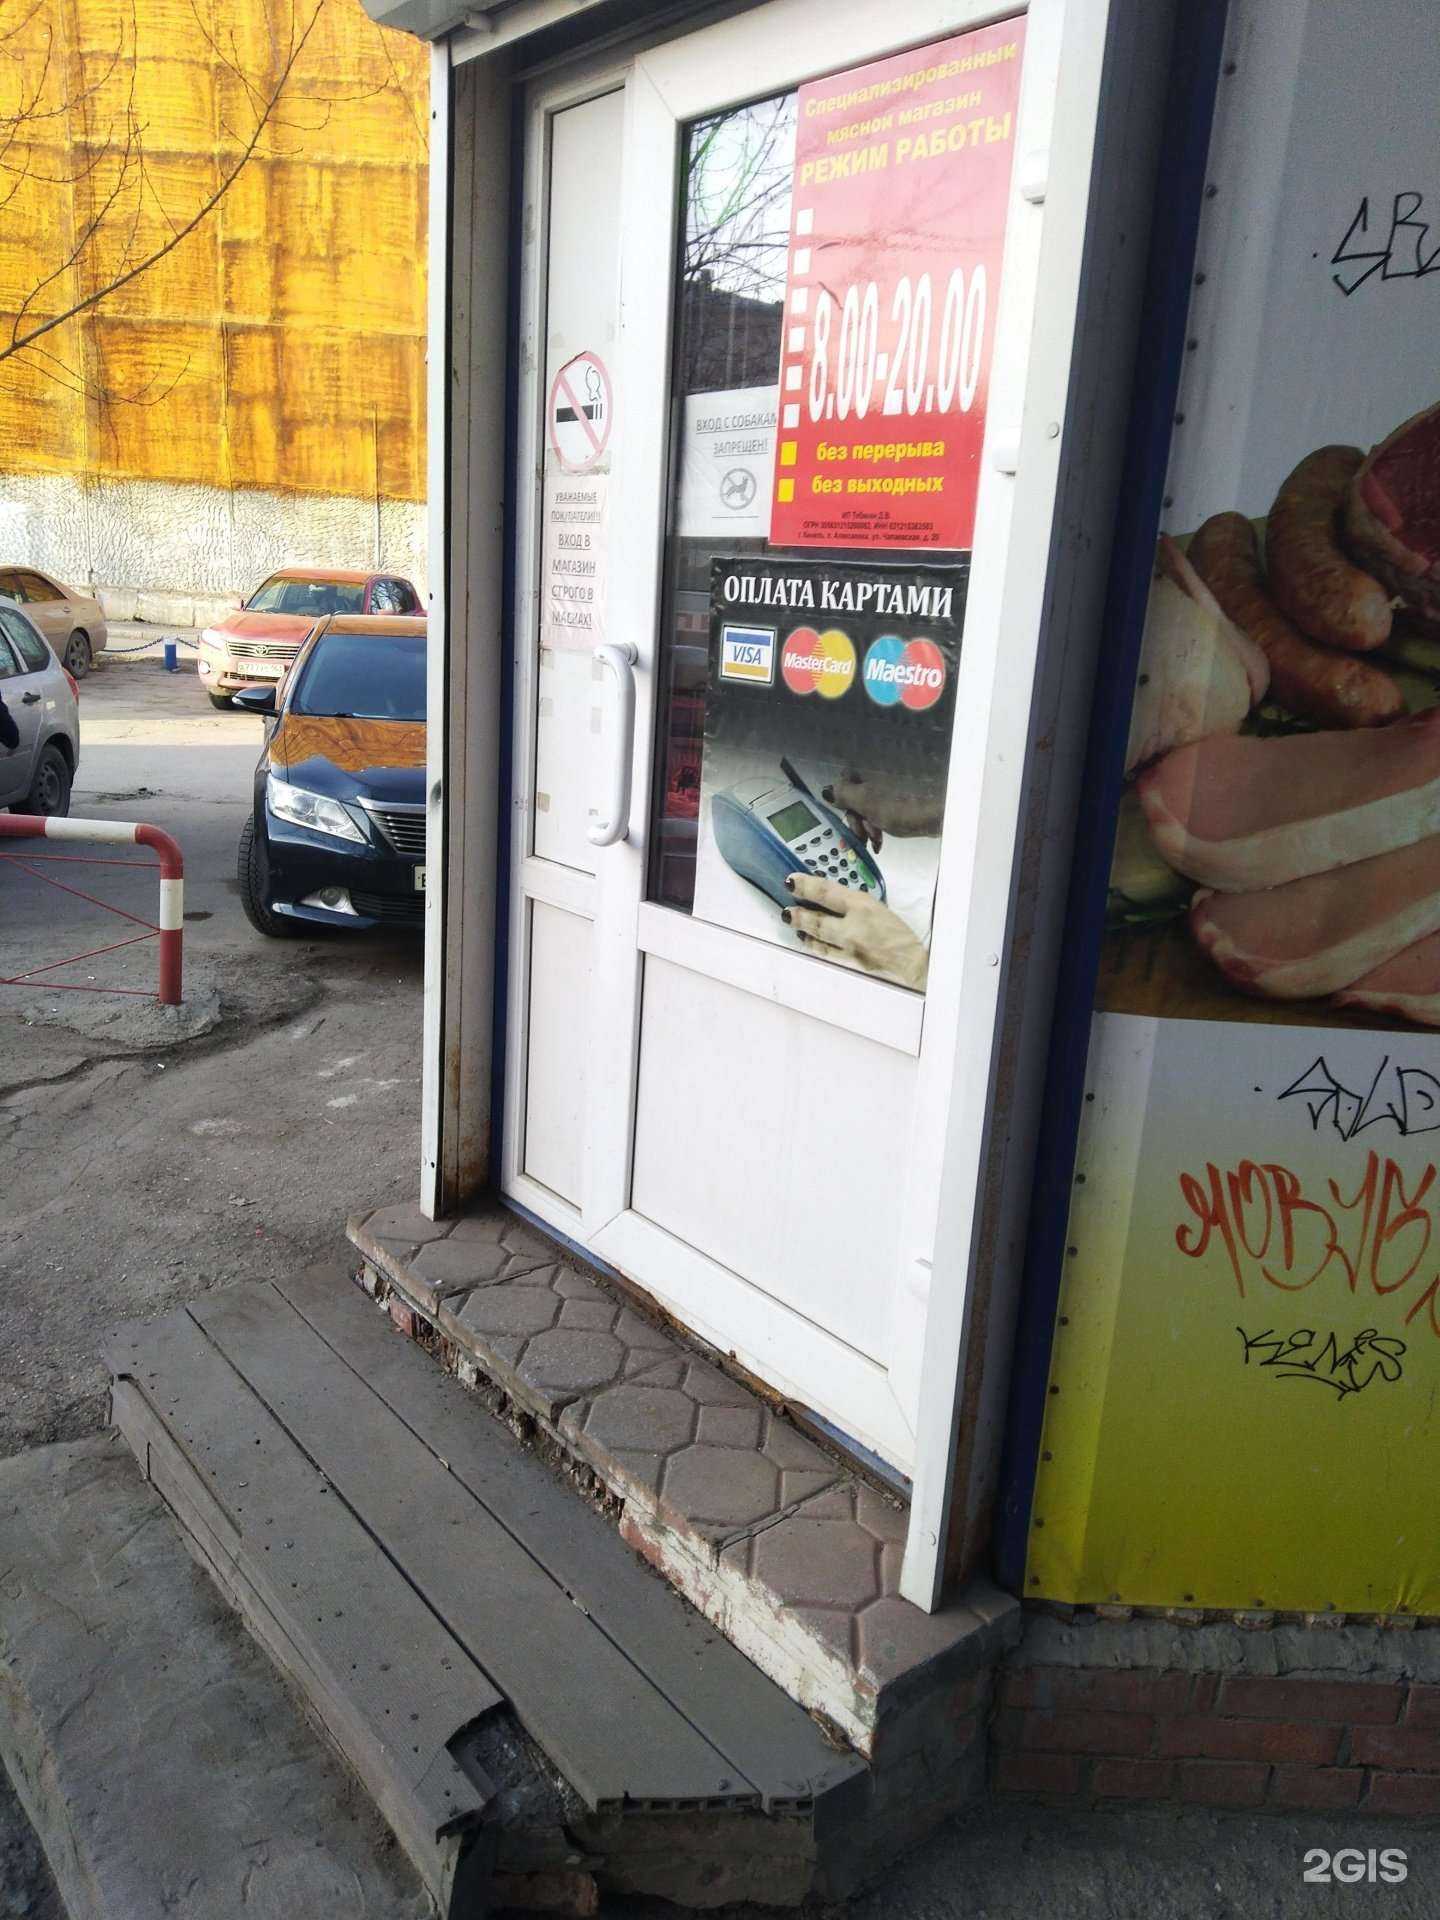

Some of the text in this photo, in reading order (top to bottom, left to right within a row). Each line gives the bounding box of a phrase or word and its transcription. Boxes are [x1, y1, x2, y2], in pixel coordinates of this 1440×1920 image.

[899, 89, 983, 126] магазин
[800, 112, 1012, 187] РЕЖИМ РАБОТЫ
[809, 264, 987, 423] 8.00-20.00
[696, 417, 721, 432] ВХОД
[816, 441, 945, 463] без перерыва
[811, 475, 944, 496] без выходных
[558, 533, 591, 548] ВХОД В
[552, 559, 596, 574] МАГАЗИН
[552, 584, 594, 601] СТРОГО В
[724, 575, 953, 618] ОПЛАТА КАРТАМИ
[732, 645, 942, 688] VISA MasterCard Maestro
